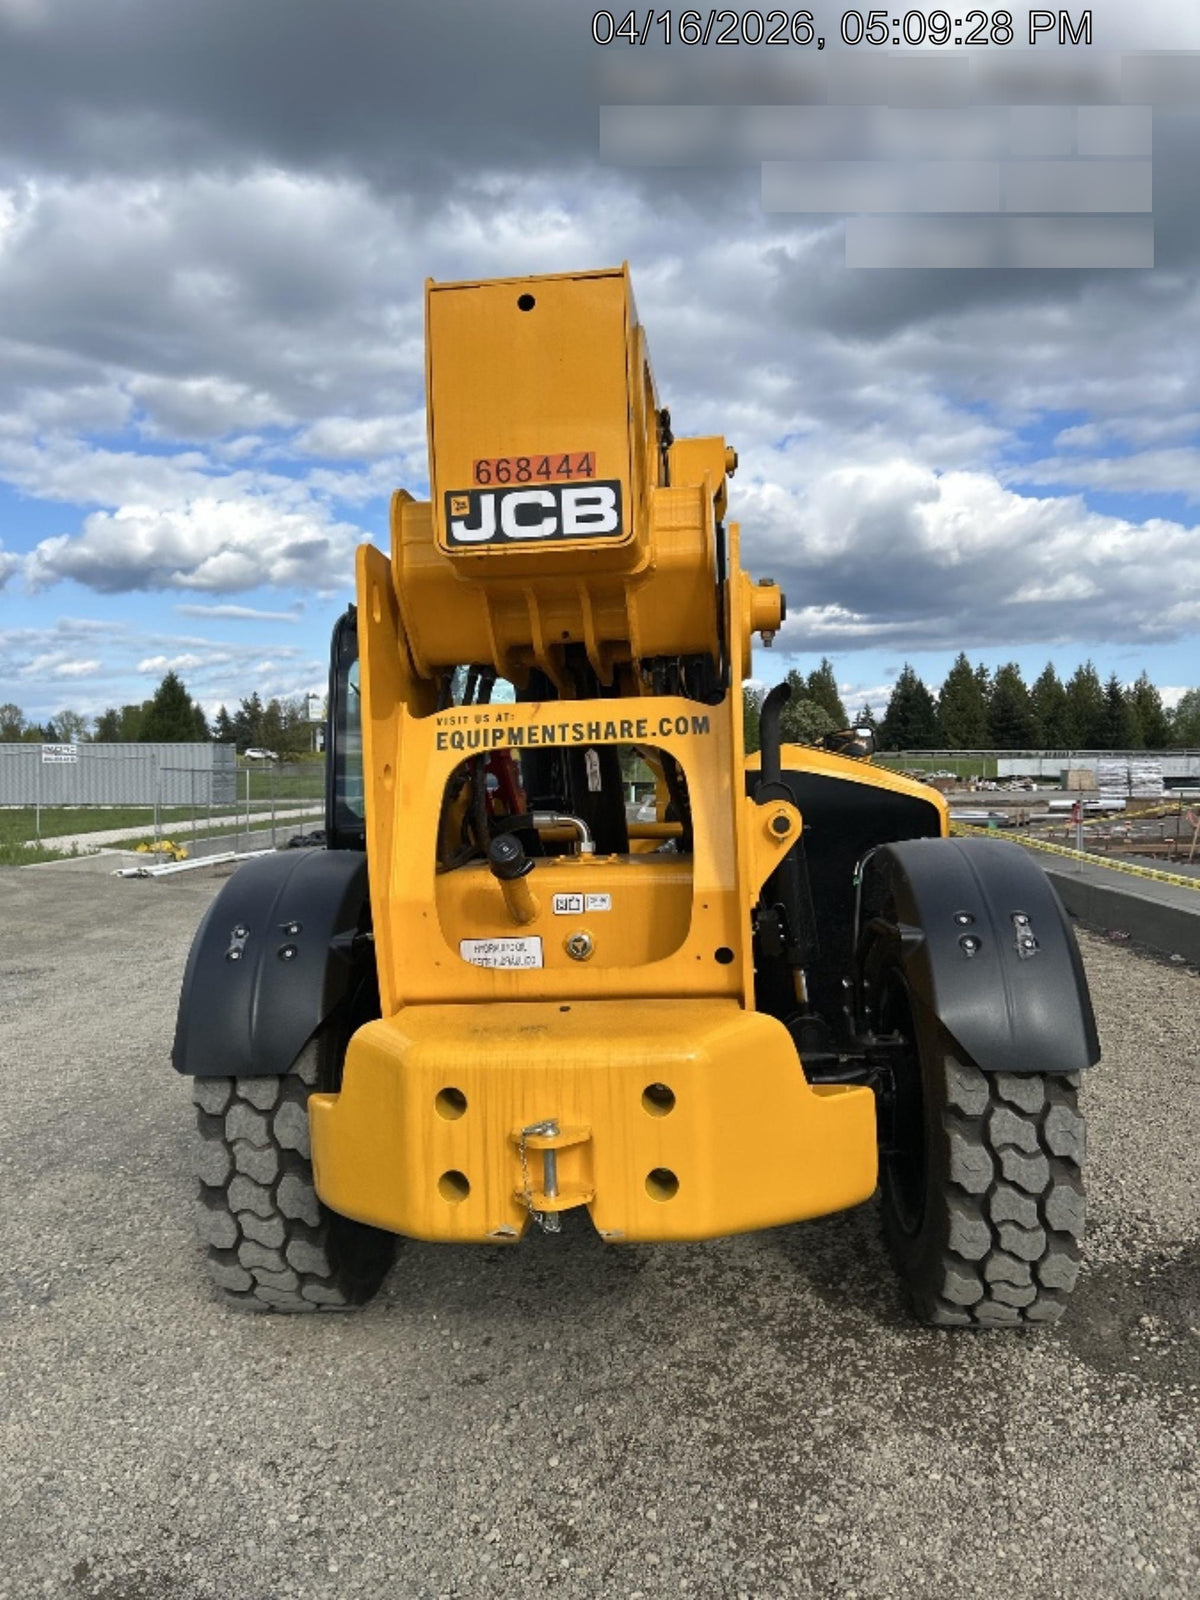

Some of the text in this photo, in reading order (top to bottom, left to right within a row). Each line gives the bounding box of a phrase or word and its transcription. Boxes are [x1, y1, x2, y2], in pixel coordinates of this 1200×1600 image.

[475, 453, 593, 484] 668444
[451, 486, 618, 541] JCB
[436, 716, 469, 726] VISIT
[474, 714, 490, 724] US
[436, 715, 710, 751] EQUIPMENTSHARE.COM
